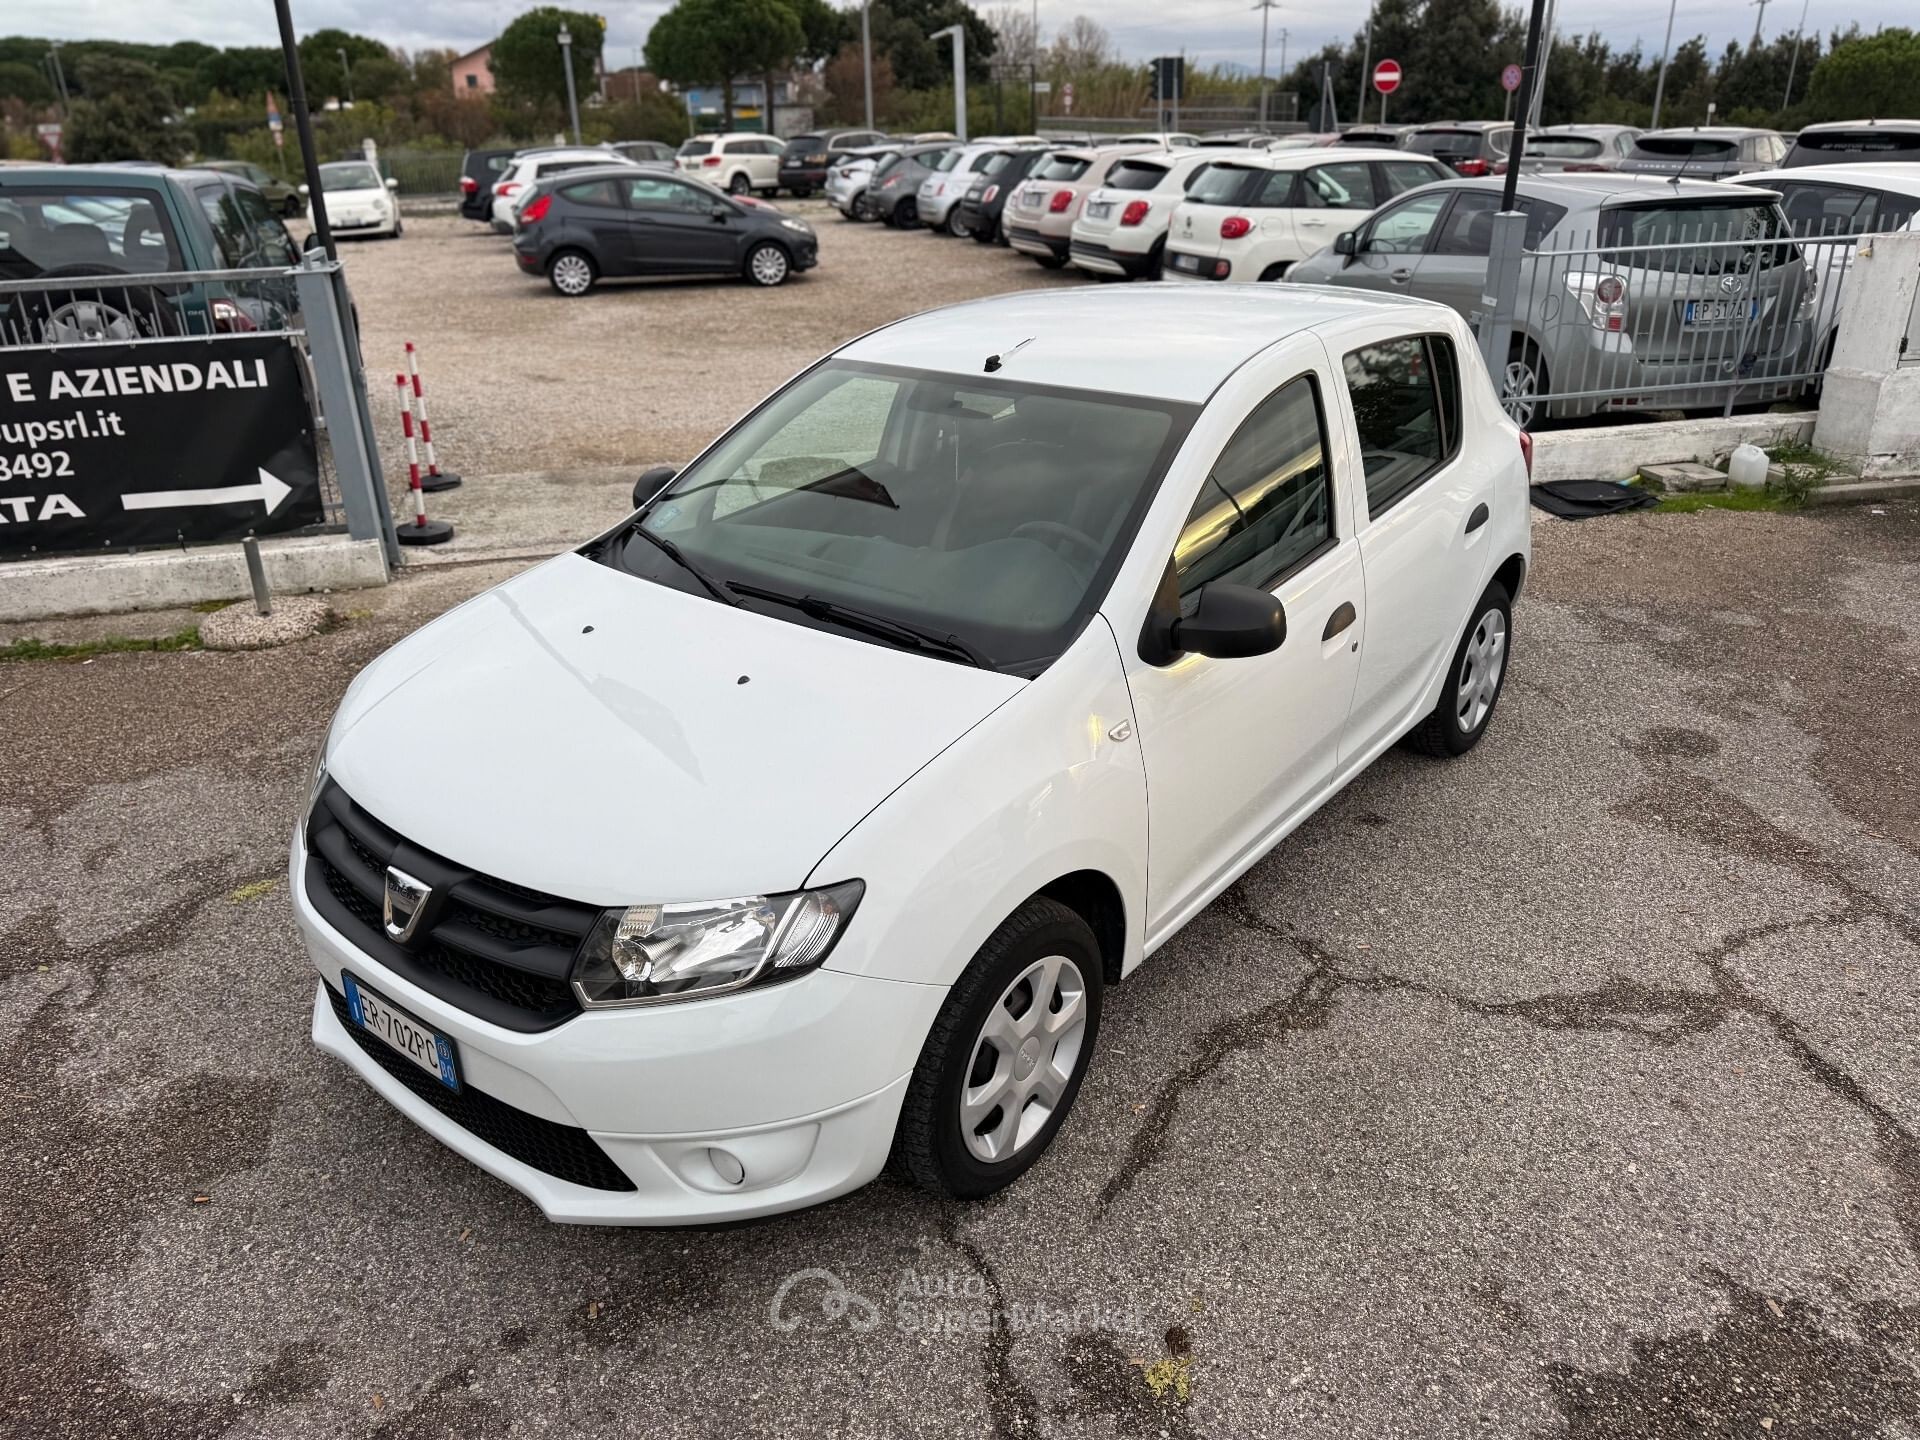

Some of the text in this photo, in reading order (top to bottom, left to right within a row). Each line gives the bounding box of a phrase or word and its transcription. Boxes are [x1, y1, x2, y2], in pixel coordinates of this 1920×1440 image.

[6, 359, 269, 402] E AZIENDALI
[0, 410, 125, 448] upsrl.it
[0, 494, 87, 524] TA
